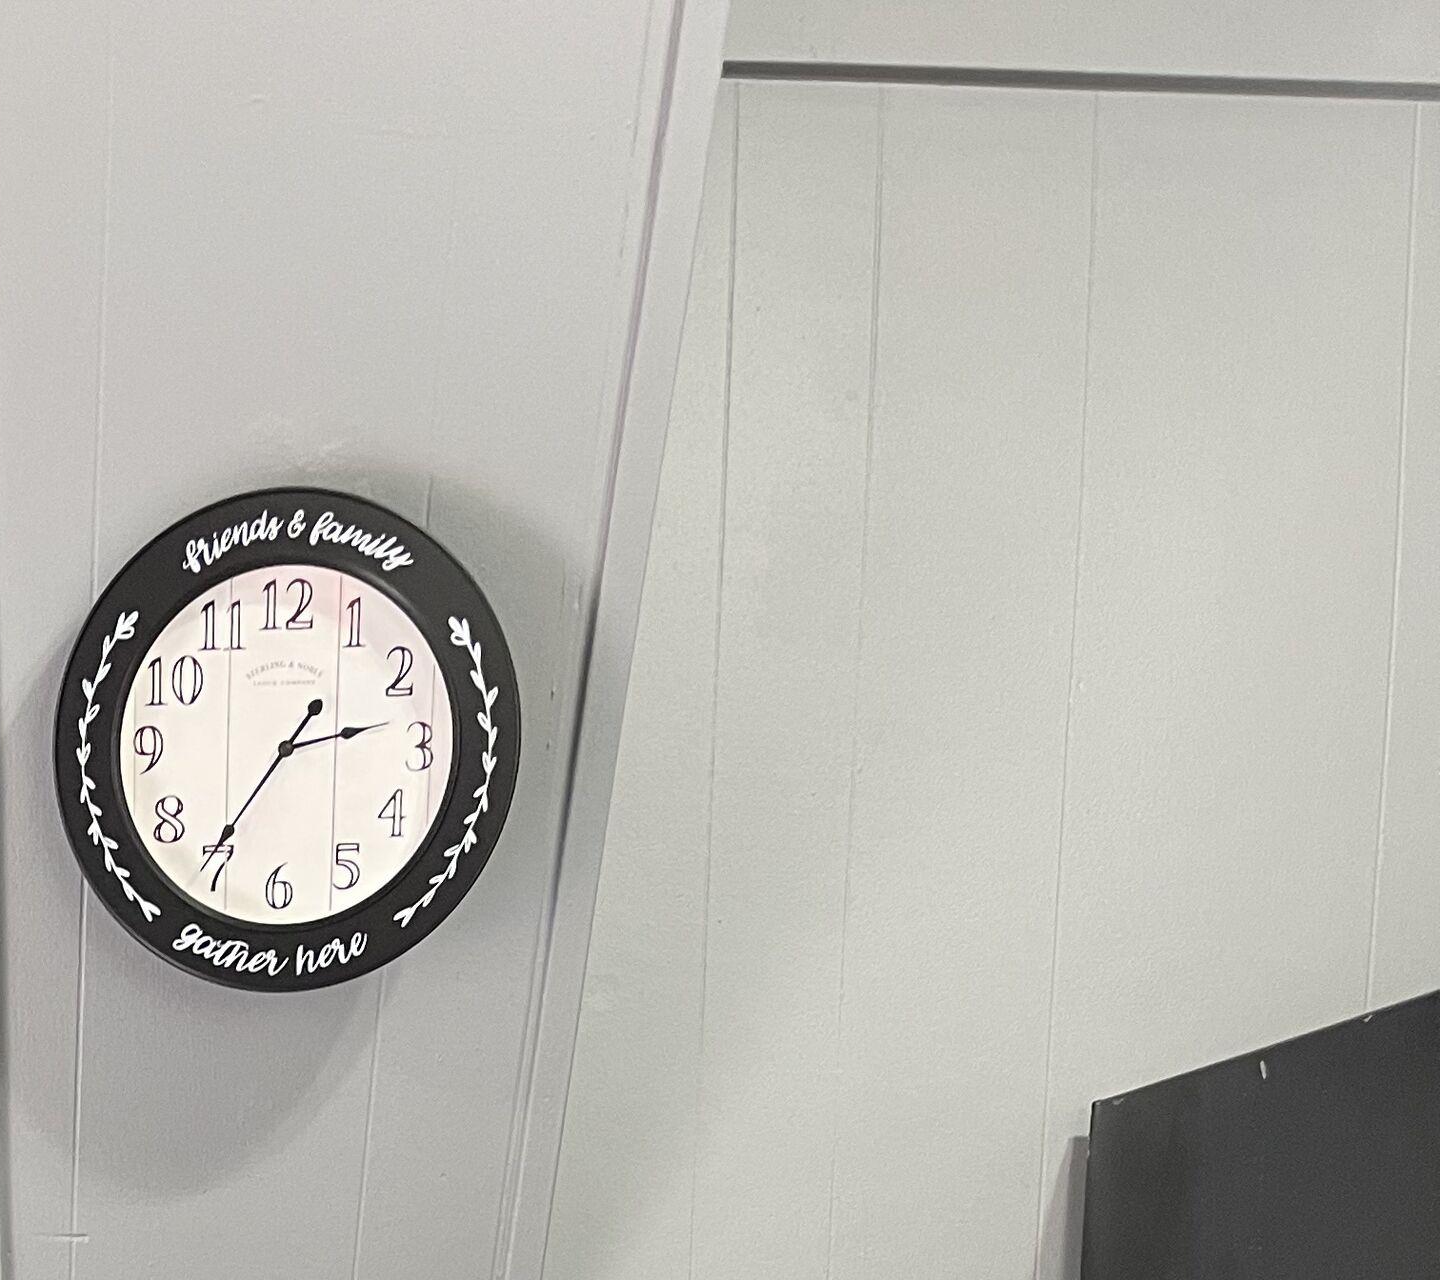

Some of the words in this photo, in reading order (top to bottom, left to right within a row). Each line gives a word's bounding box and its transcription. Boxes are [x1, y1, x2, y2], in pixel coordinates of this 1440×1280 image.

[182, 509, 283, 573] friends
[287, 509, 306, 539] &
[309, 511, 414, 571] family
[197, 599, 246, 651] 11
[259, 578, 314, 630] 12
[343, 596, 366, 648] 1
[145, 655, 203, 706] 10
[385, 646, 414, 697] 2
[133, 725, 164, 775] 9
[405, 721, 434, 771] 3
[153, 795, 185, 844] 8
[377, 788, 407, 838] 4
[202, 844, 235, 892] 7
[265, 861, 293, 909] 6
[333, 842, 361, 890] 5
[172, 923, 290, 976] gather
[296, 932, 368, 976] here
